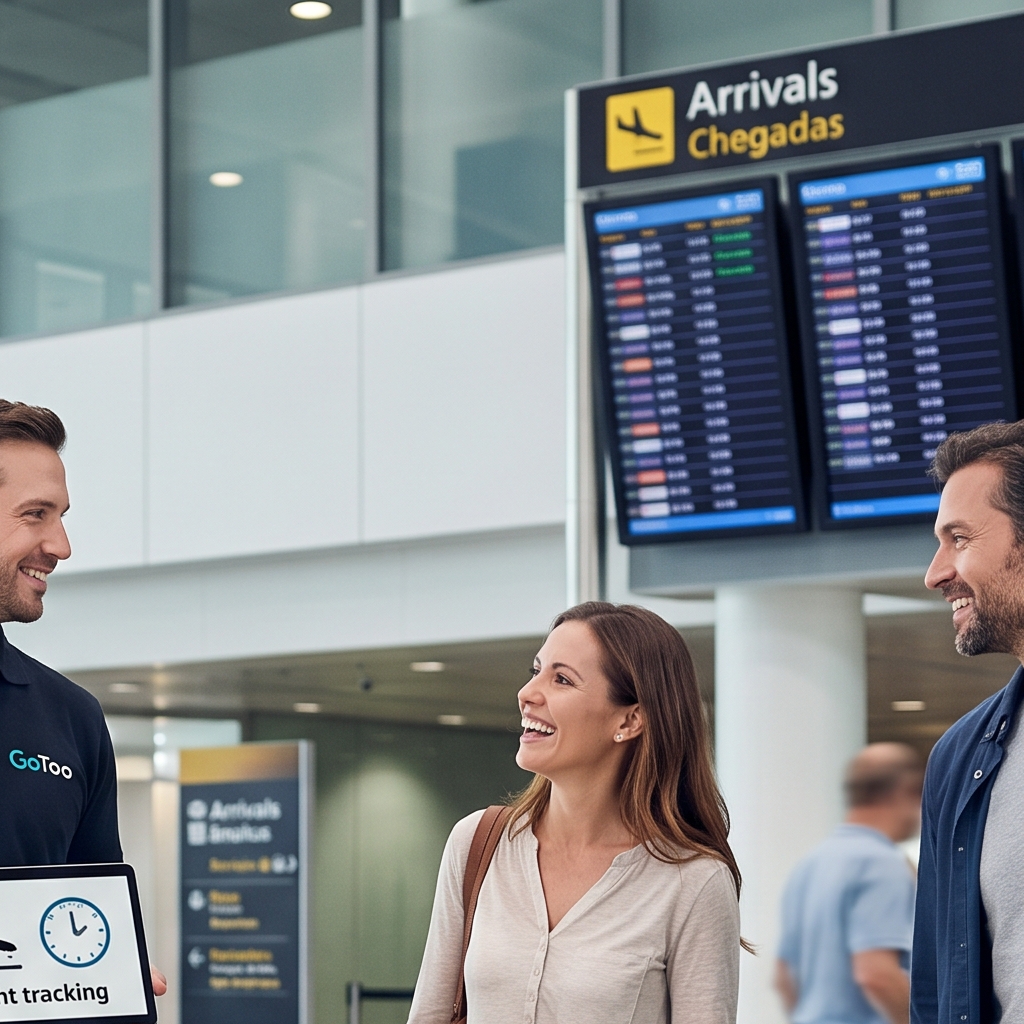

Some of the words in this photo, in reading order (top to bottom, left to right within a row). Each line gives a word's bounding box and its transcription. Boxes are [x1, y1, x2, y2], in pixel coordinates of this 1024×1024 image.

[686, 59, 839, 121] Arrivals
[687, 110, 845, 159] Chegadas
[9, 749, 73, 780] GoToo
[22, 983, 109, 1005] tracking
